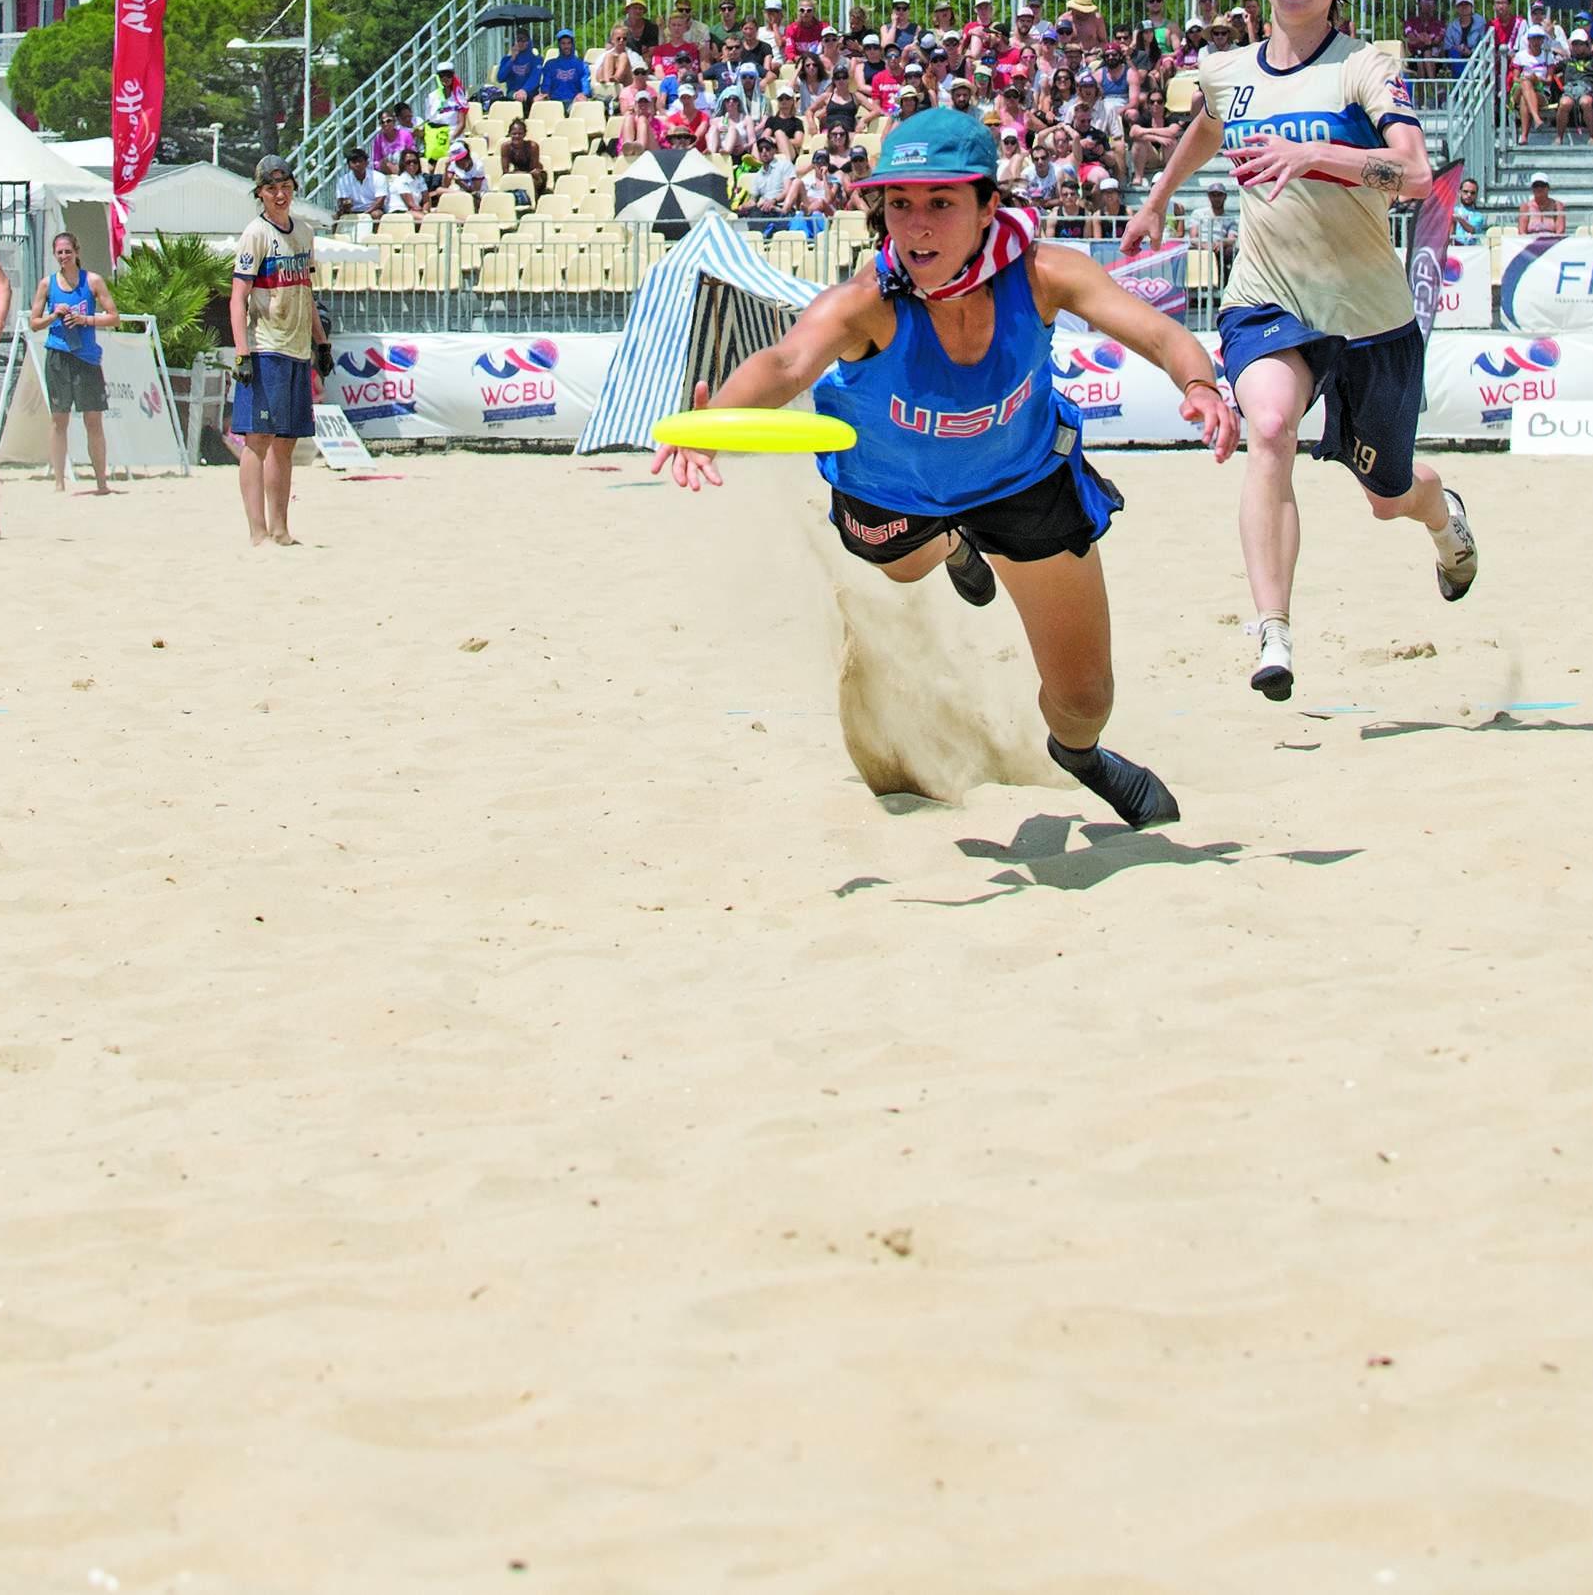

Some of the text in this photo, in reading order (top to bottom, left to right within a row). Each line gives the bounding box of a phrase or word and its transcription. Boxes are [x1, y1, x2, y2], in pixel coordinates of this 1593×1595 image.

[1228, 85, 1254, 120] 19
[342, 378, 416, 406] WCBU
[481, 380, 556, 407] WCBU
[889, 369, 1033, 439] USA
[1063, 382, 1121, 404] CBU
[1479, 378, 1557, 407] WCBU
[1353, 436, 1377, 475] 19
[844, 509, 909, 545] USA
